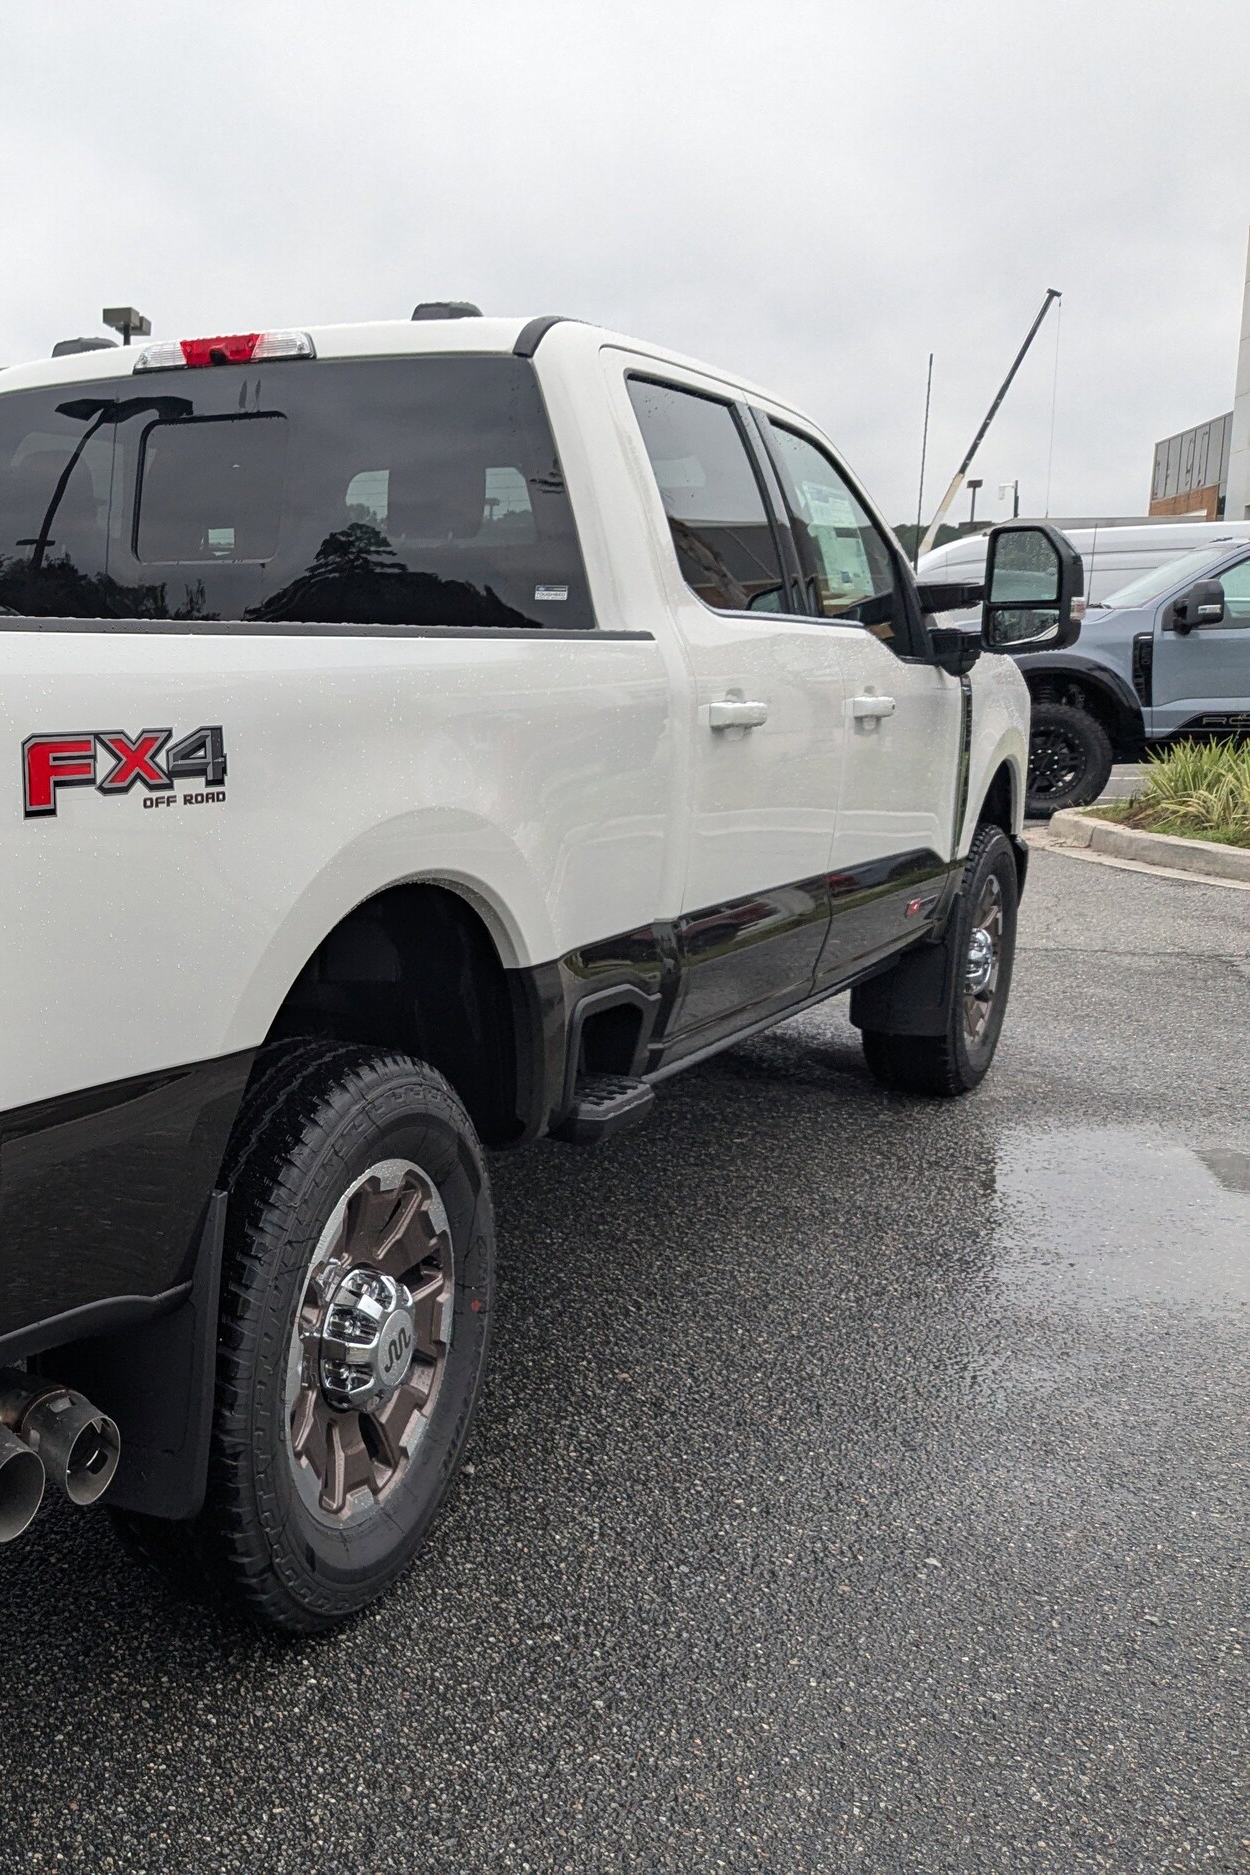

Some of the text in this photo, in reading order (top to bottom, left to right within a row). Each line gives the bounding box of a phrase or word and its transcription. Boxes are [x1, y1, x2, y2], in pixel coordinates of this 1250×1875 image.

[21, 725, 228, 820] FX4
[143, 791, 226, 809] OFF ROAD
